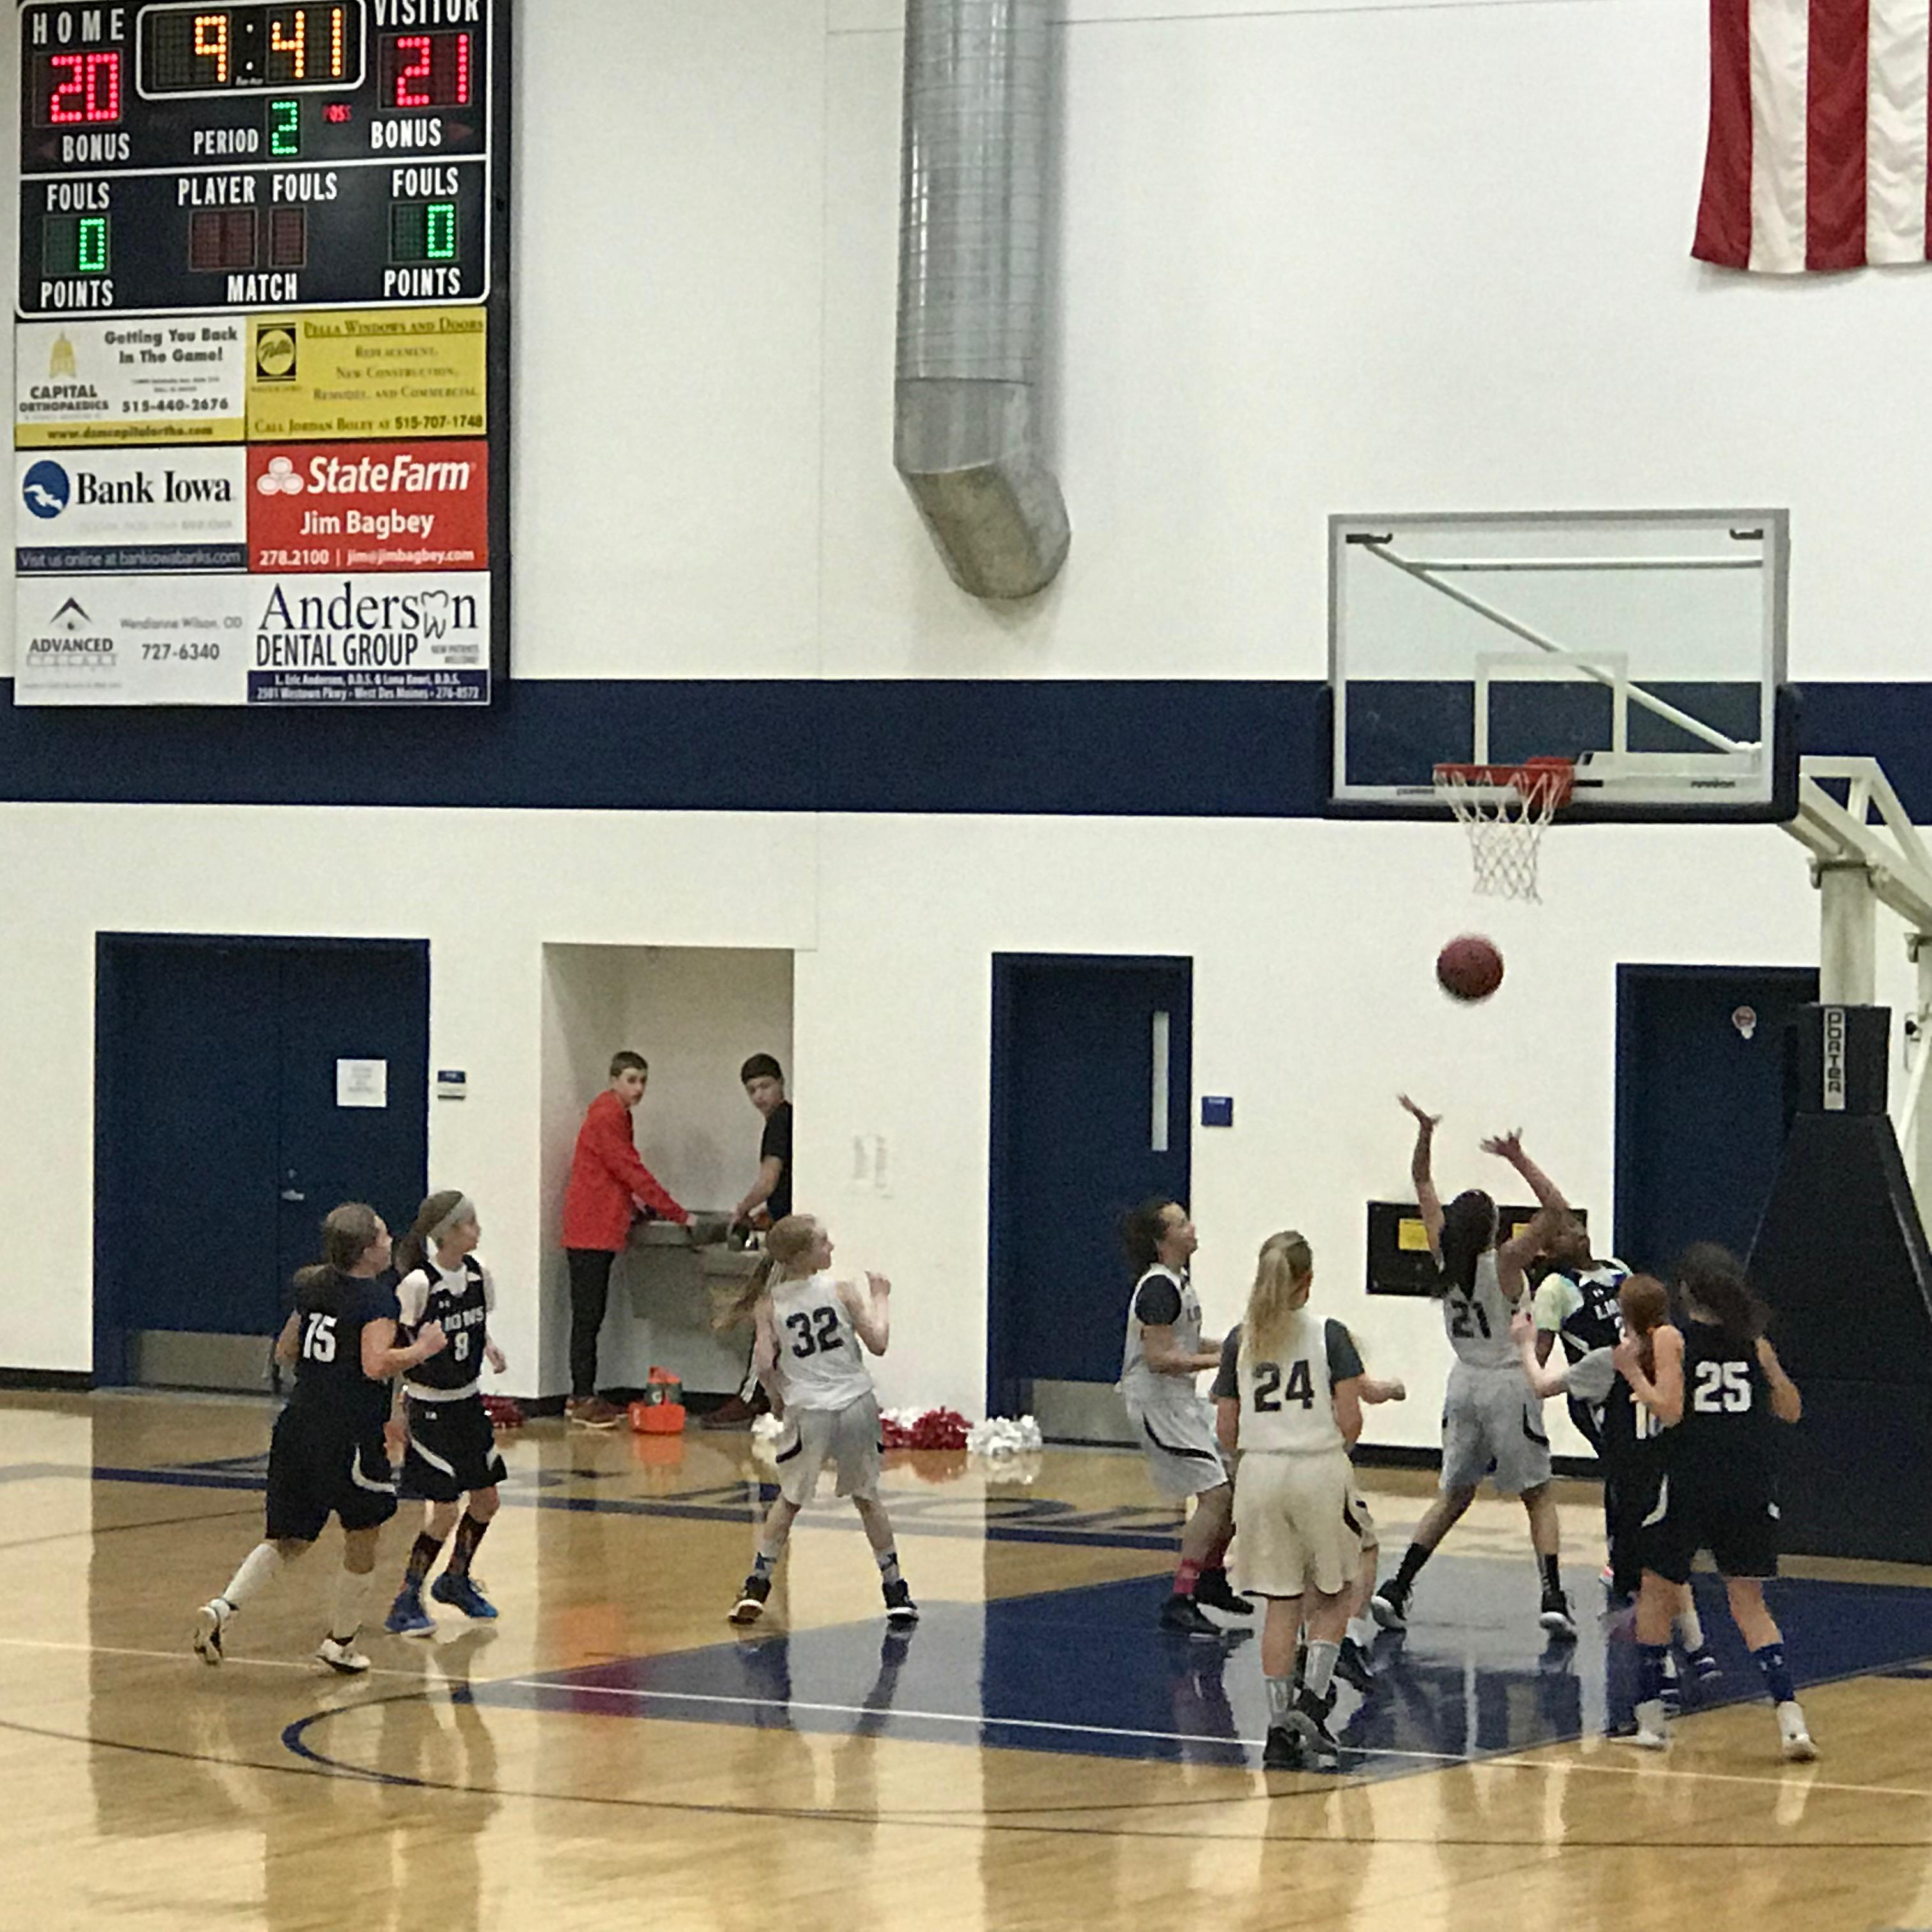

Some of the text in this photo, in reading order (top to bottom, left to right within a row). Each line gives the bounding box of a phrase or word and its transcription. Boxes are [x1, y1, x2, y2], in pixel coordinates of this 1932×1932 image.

[33, 8, 125, 44] HOME
[375, 0, 478, 26] VISITOR
[397, 33, 468, 107] 21
[51, 52, 119, 122] 20
[194, 128, 259, 155] PERIOD
[272, 101, 298, 155] 2
[371, 118, 441, 149] BONUS
[63, 133, 130, 162] BONUS
[47, 181, 111, 211] FOULS
[178, 172, 338, 206] PLAYER FOULS
[392, 167, 459, 197] FOULS
[79, 217, 105, 271] 0
[427, 204, 454, 258] 0
[40, 279, 114, 309] POINTS
[227, 273, 298, 302] MATCH
[383, 268, 461, 297] POINTS
[104, 326, 238, 347] Getting You Back
[119, 346, 223, 364] In The Game!
[19, 401, 109, 413] ORTHOPAEDICS
[30, 385, 97, 399] CAPITAL
[122, 398, 229, 413] 515-440-2676
[395, 414, 483, 429] 515-707-1748
[76, 470, 231, 505] Bank Iowa
[300, 508, 435, 540] Jim Bagbey
[20, 551, 45, 566] Visit
[48, 553, 62, 565] us
[65, 551, 102, 566] online
[105, 551, 118, 565] at
[259, 549, 330, 566] 278.2100
[29, 638, 113, 652] ADVANCED
[142, 643, 220, 661] 727-6340
[256, 633, 418, 666] DENTAL GROUP
[1827, 1011, 1843, 1093] PORTER
[786, 1306, 845, 1358] 32
[1450, 1300, 1492, 1340] 21
[303, 1312, 337, 1363] 15
[1253, 1360, 1315, 1413] 24
[1694, 1361, 1752, 1413] 25
